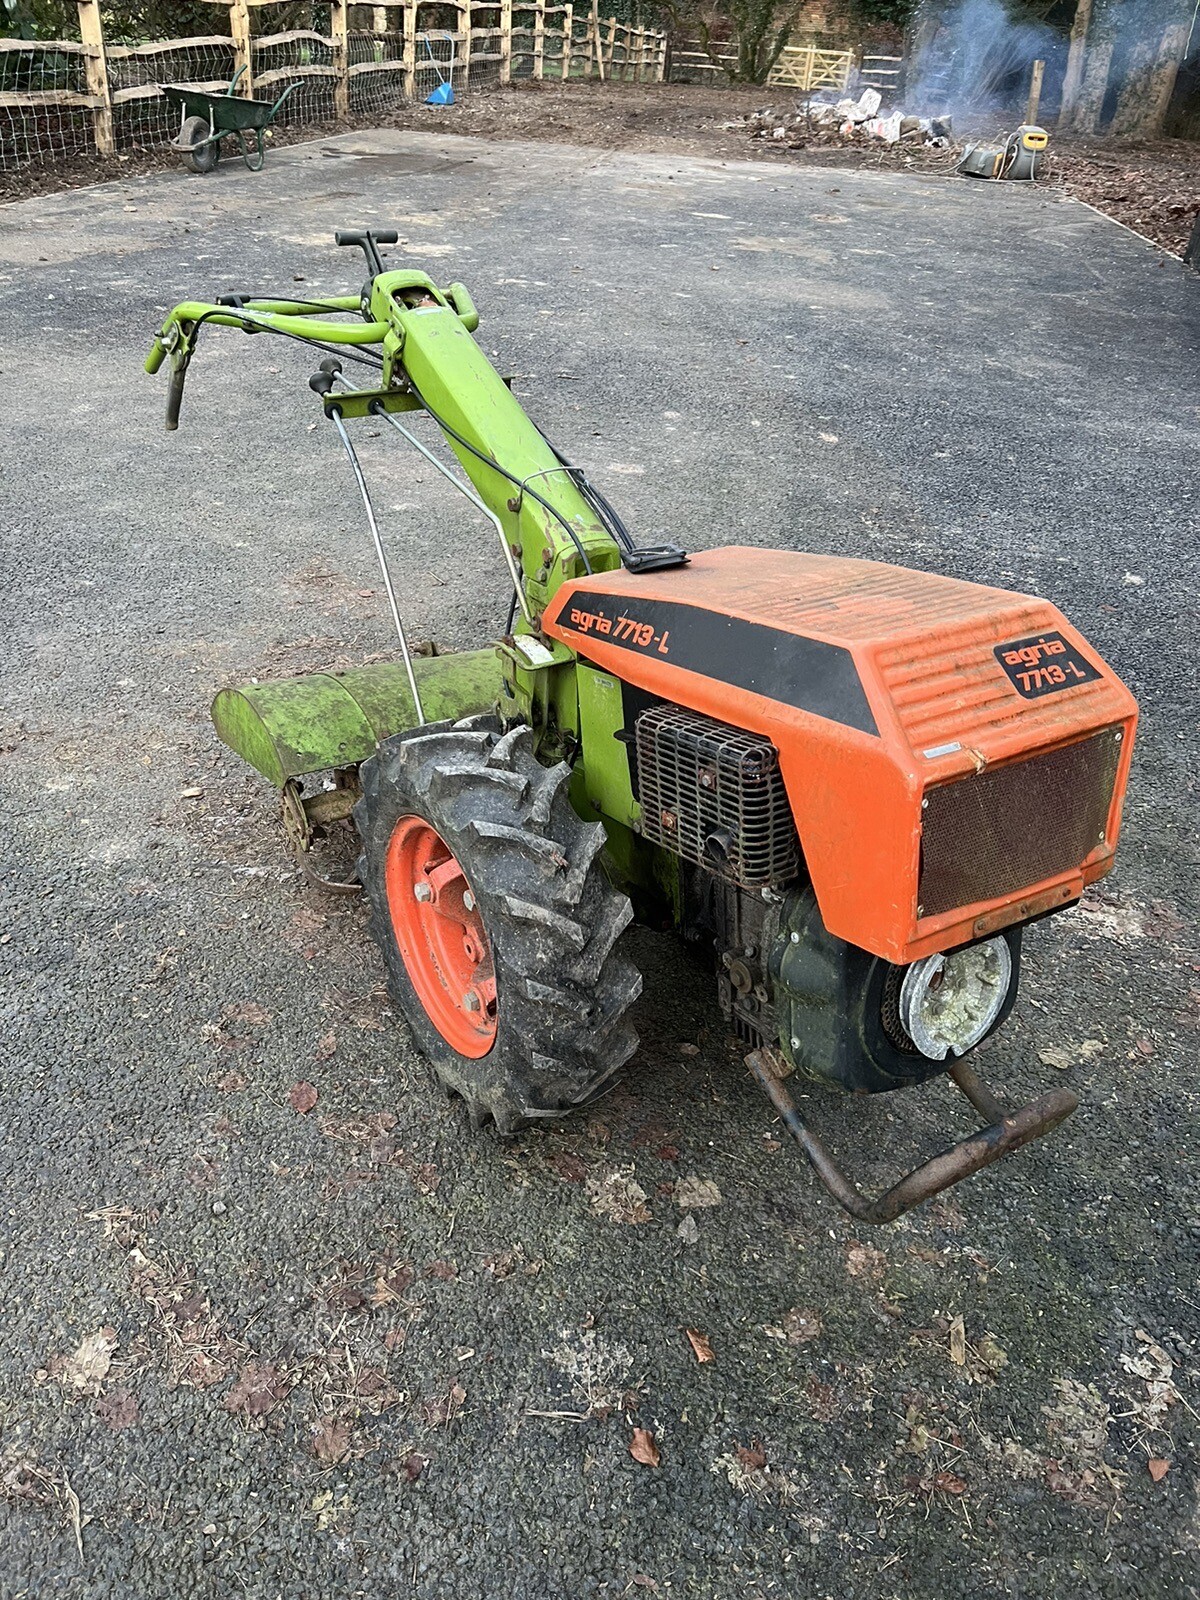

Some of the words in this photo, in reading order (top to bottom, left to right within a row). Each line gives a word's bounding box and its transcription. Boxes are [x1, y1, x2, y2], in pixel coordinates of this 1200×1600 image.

[571, 608, 612, 635] agria
[613, 617, 669, 654] 7713-L
[1002, 638, 1066, 667] agria
[1016, 661, 1086, 691] 7713-L
